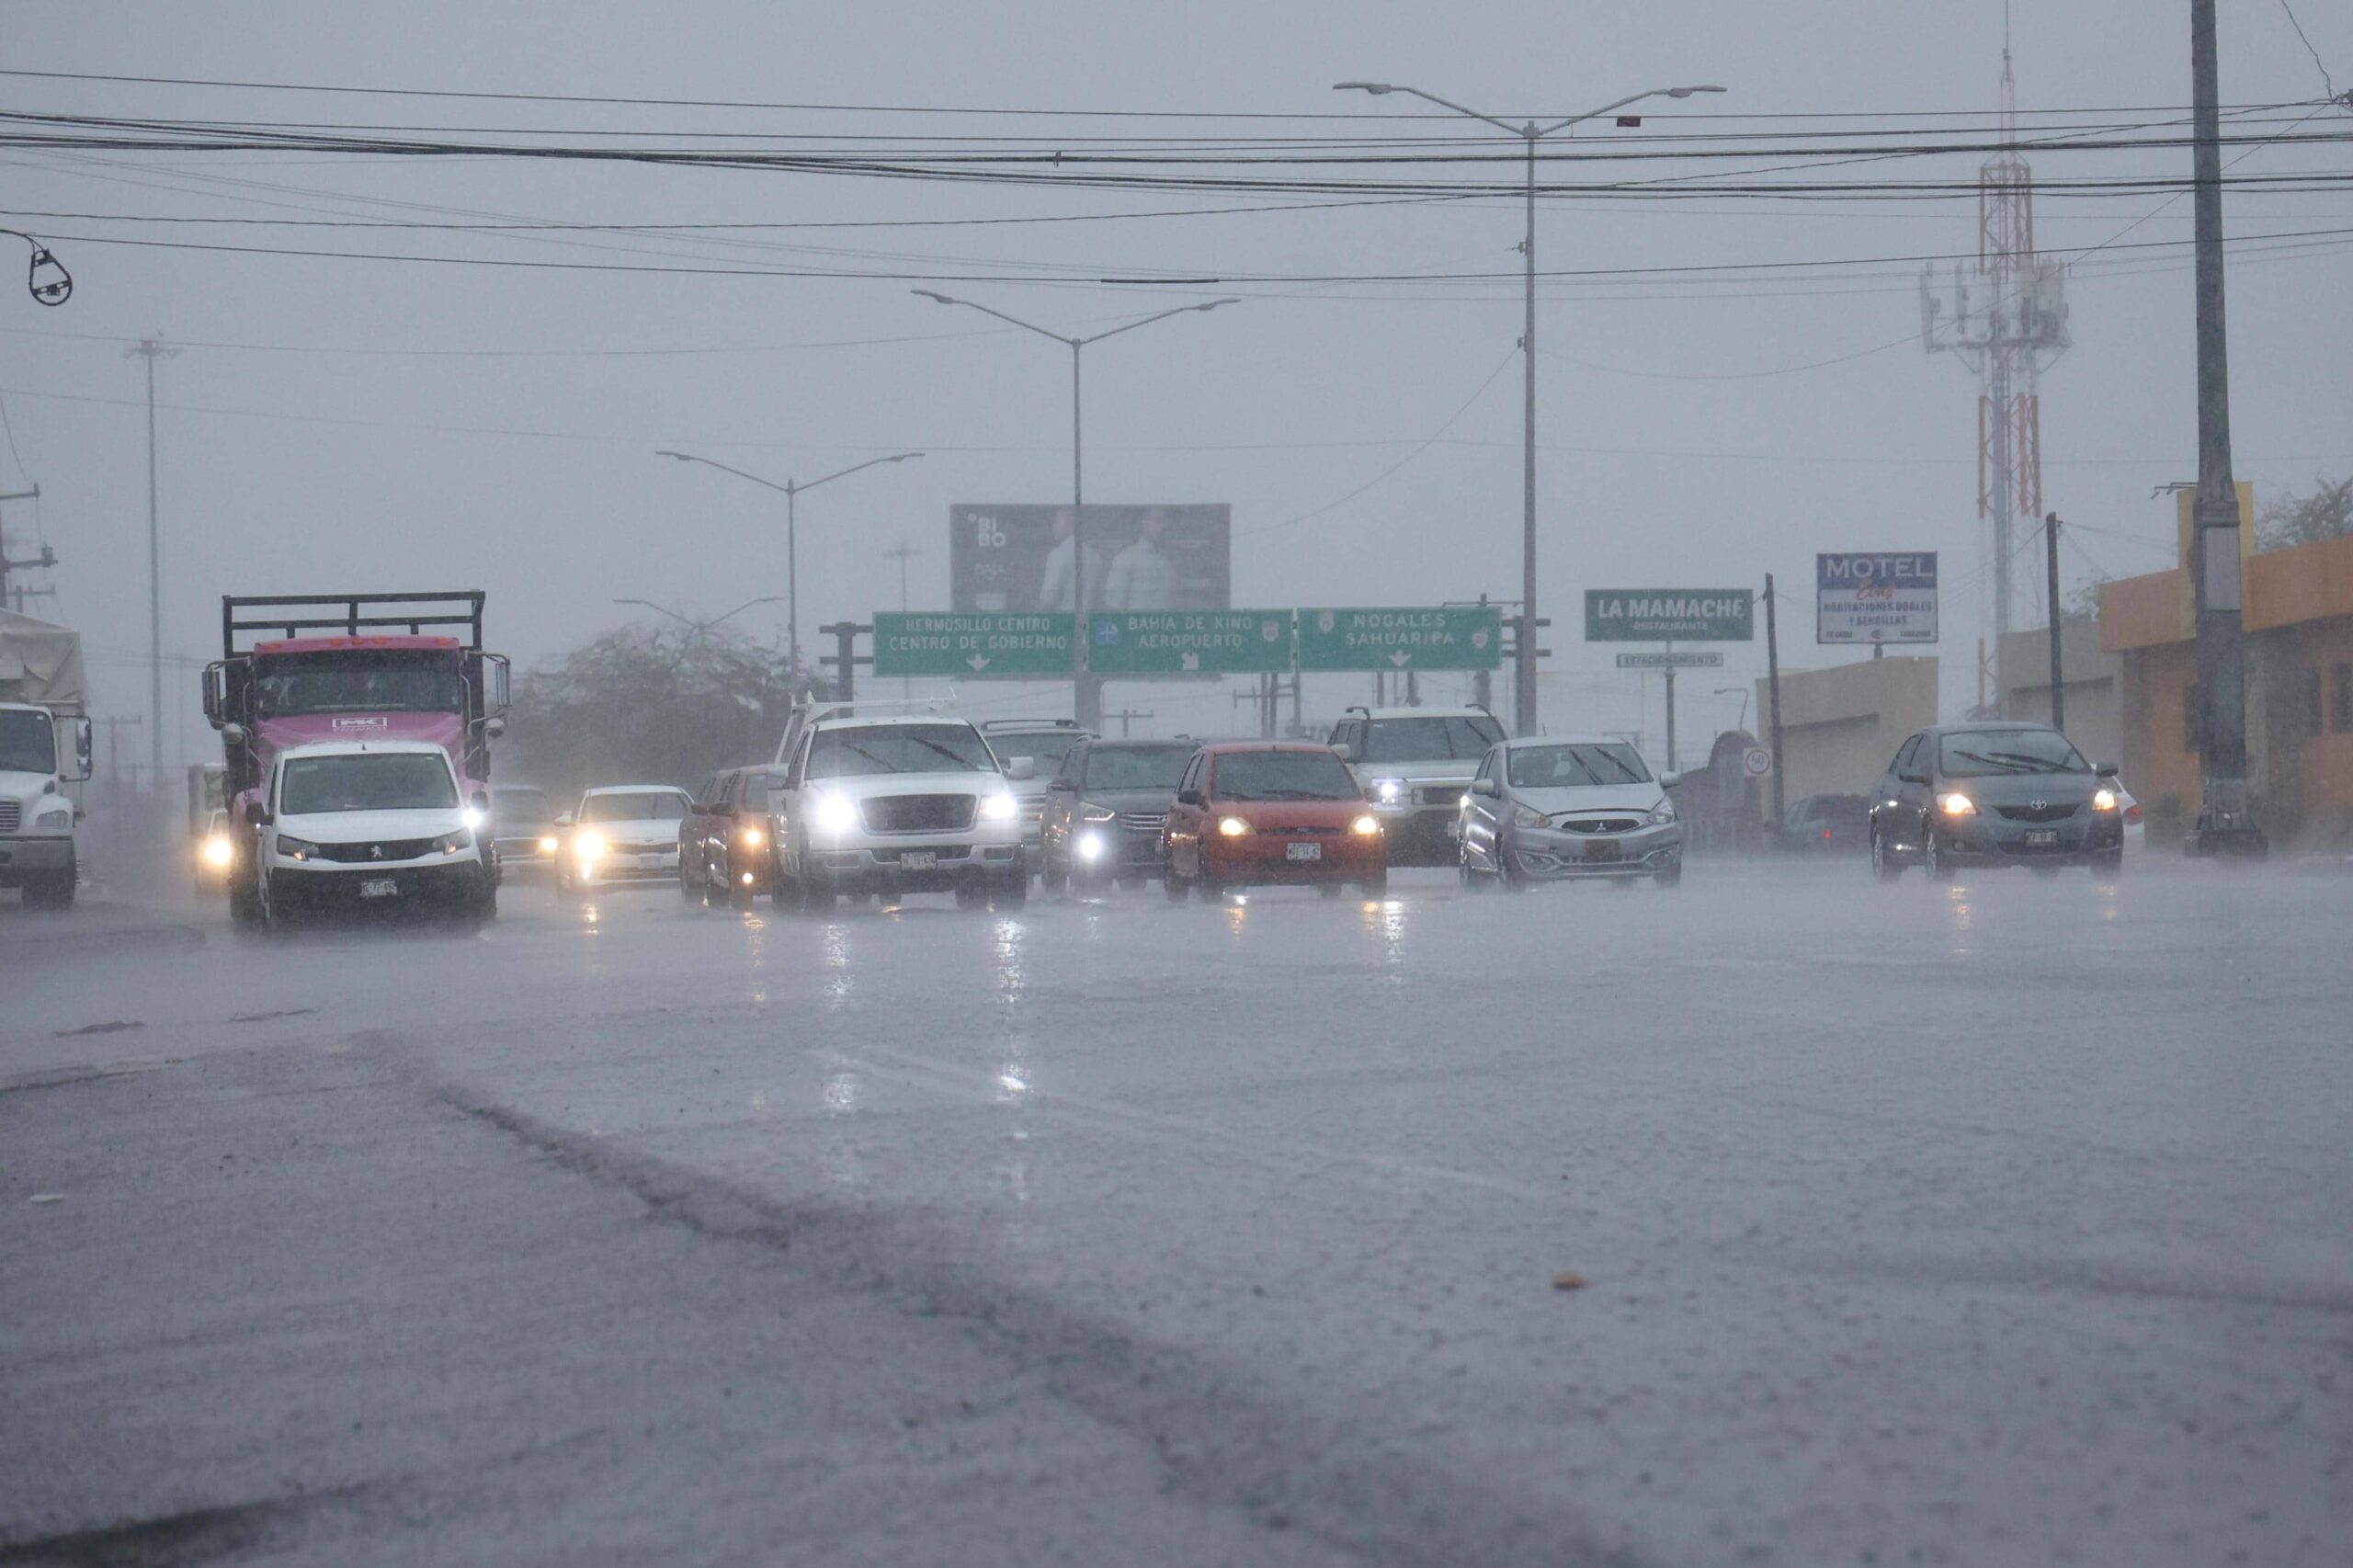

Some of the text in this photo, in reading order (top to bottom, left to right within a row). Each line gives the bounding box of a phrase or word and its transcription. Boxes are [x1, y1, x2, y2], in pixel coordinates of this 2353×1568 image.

[1826, 558, 1935, 578] MOTEL
[1597, 598, 1744, 618] LA MAMACHE
[906, 617, 1050, 632] HERMOSILLO CENTRO
[1185, 616, 1205, 629] DE
[1215, 616, 1253, 629] KINO
[1354, 613, 1446, 628] NOGALES
[890, 634, 1066, 651] CENTRO DE GOBIERNO
[1139, 633, 1243, 649] AEROPUERTO
[1345, 631, 1455, 646] SAHUARIPA
